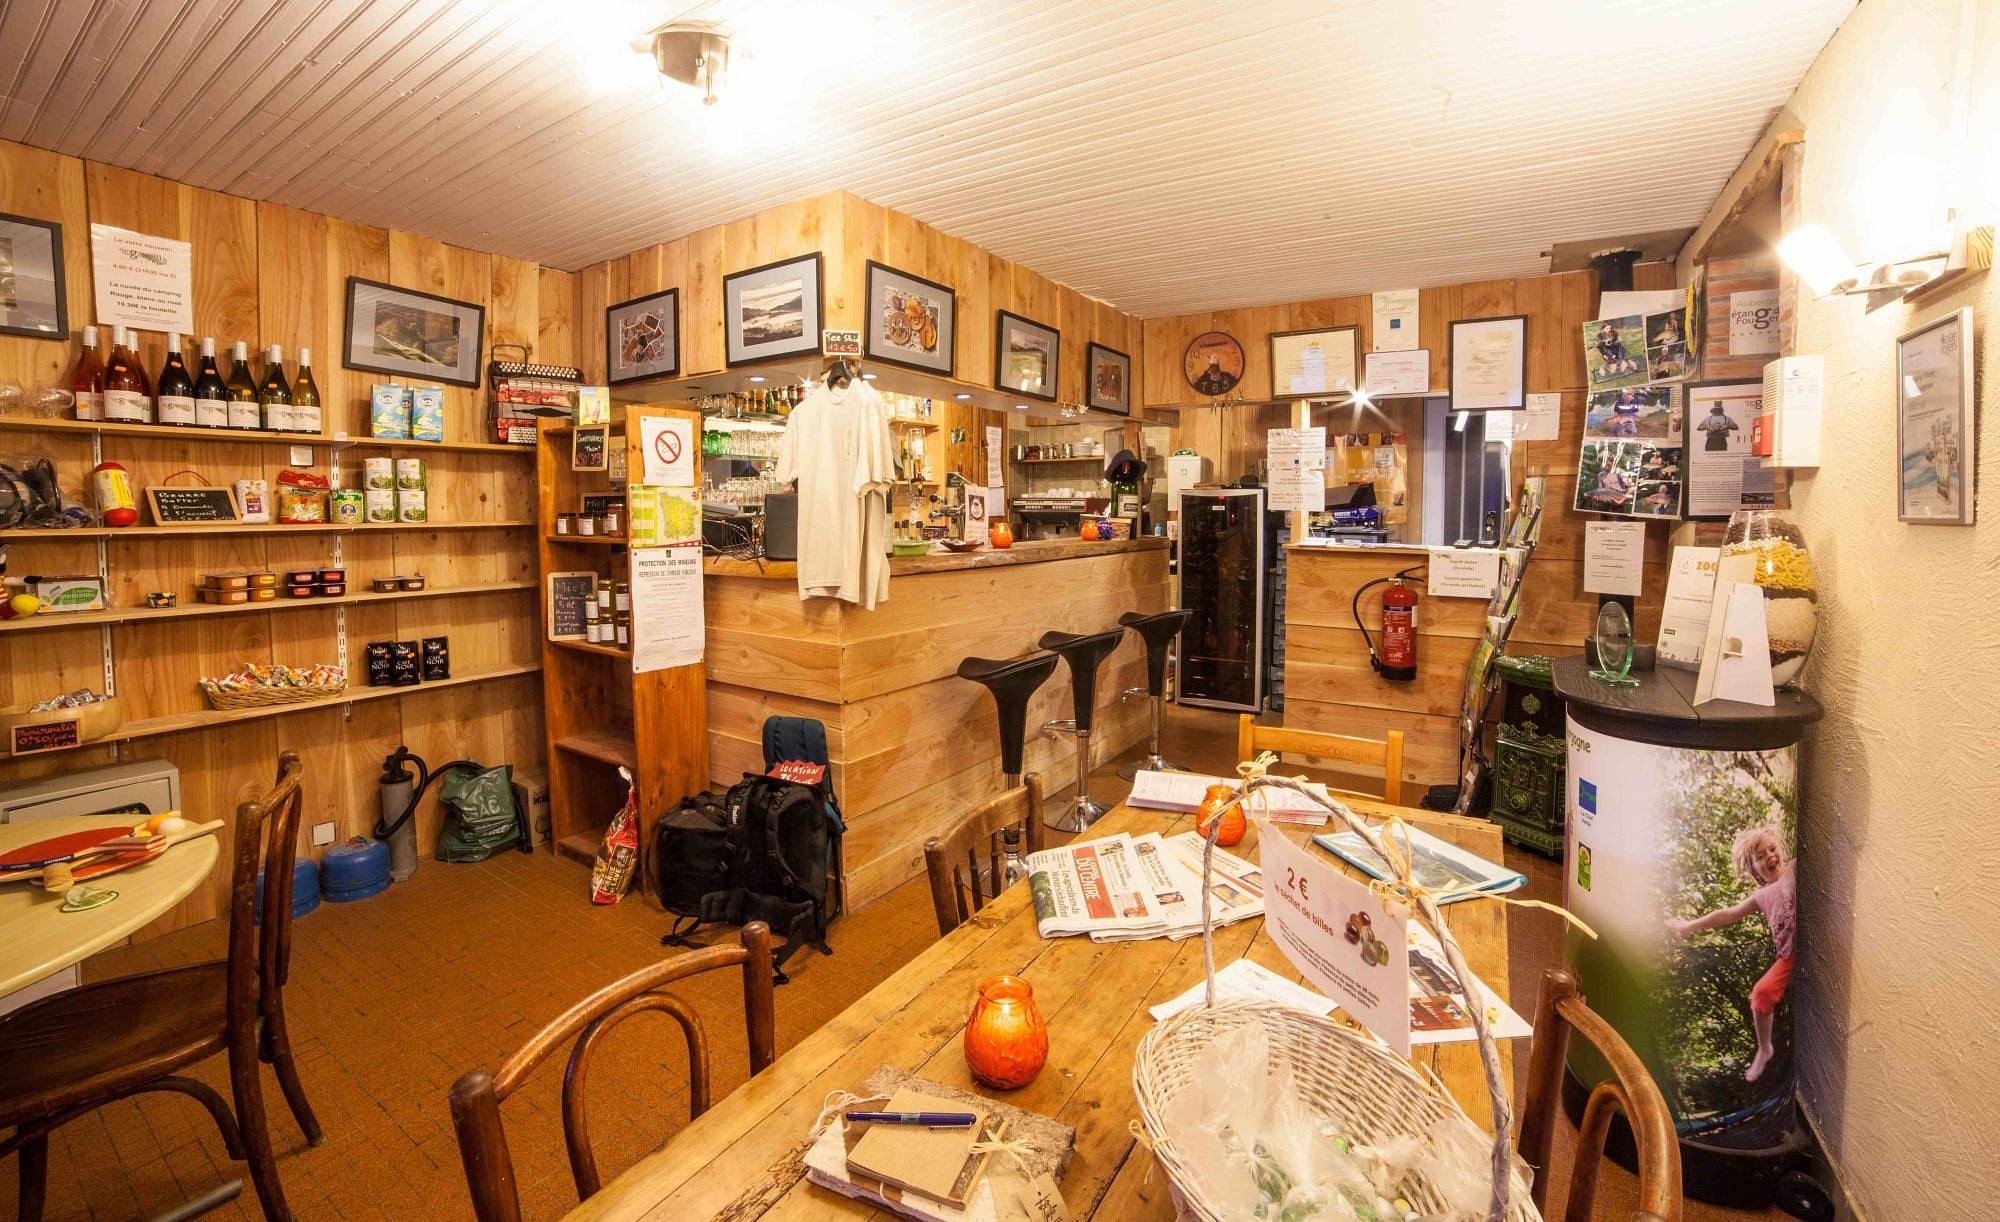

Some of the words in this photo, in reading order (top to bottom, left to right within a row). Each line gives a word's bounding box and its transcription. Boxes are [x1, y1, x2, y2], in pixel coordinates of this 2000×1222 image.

[638, 559, 666, 567] PROTECTION
[395, 663, 414, 671] NOIR
[780, 764, 819, 775] LOCATION
[1076, 858, 1093, 870] DU
[1080, 870, 1101, 900] CENTRE
[1287, 867, 1295, 890] 2
[1299, 877, 1308, 900] €
[1280, 888, 1301, 912] sachet
[1301, 907, 1311, 920] de
[1312, 913, 1334, 936] billes
